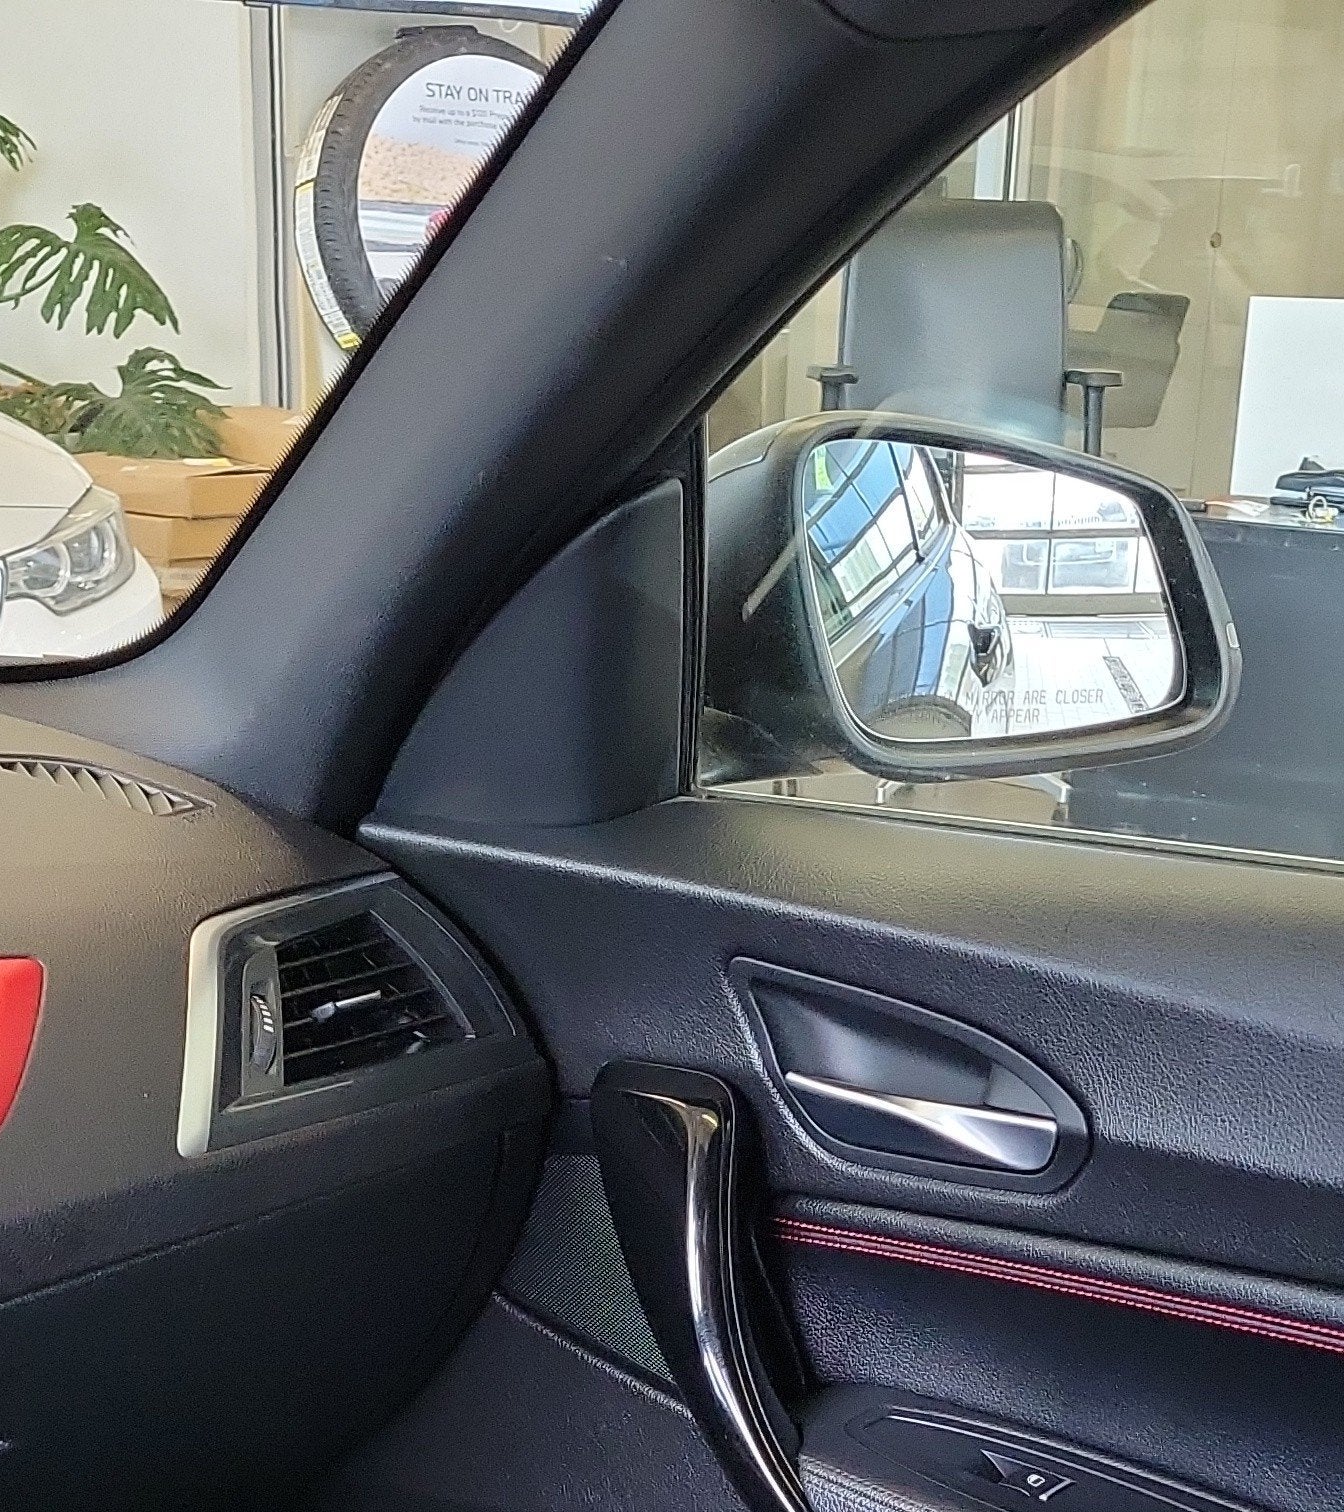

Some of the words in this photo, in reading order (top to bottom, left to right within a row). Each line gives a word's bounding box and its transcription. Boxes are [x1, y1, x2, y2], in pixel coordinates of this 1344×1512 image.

[425, 82, 463, 101] STAY
[467, 87, 490, 103] ON
[965, 690, 1015, 706] MIRROR
[1023, 689, 1047, 705] ARE
[1055, 688, 1104, 705] CLOSER
[991, 708, 1041, 724] APPEAR
